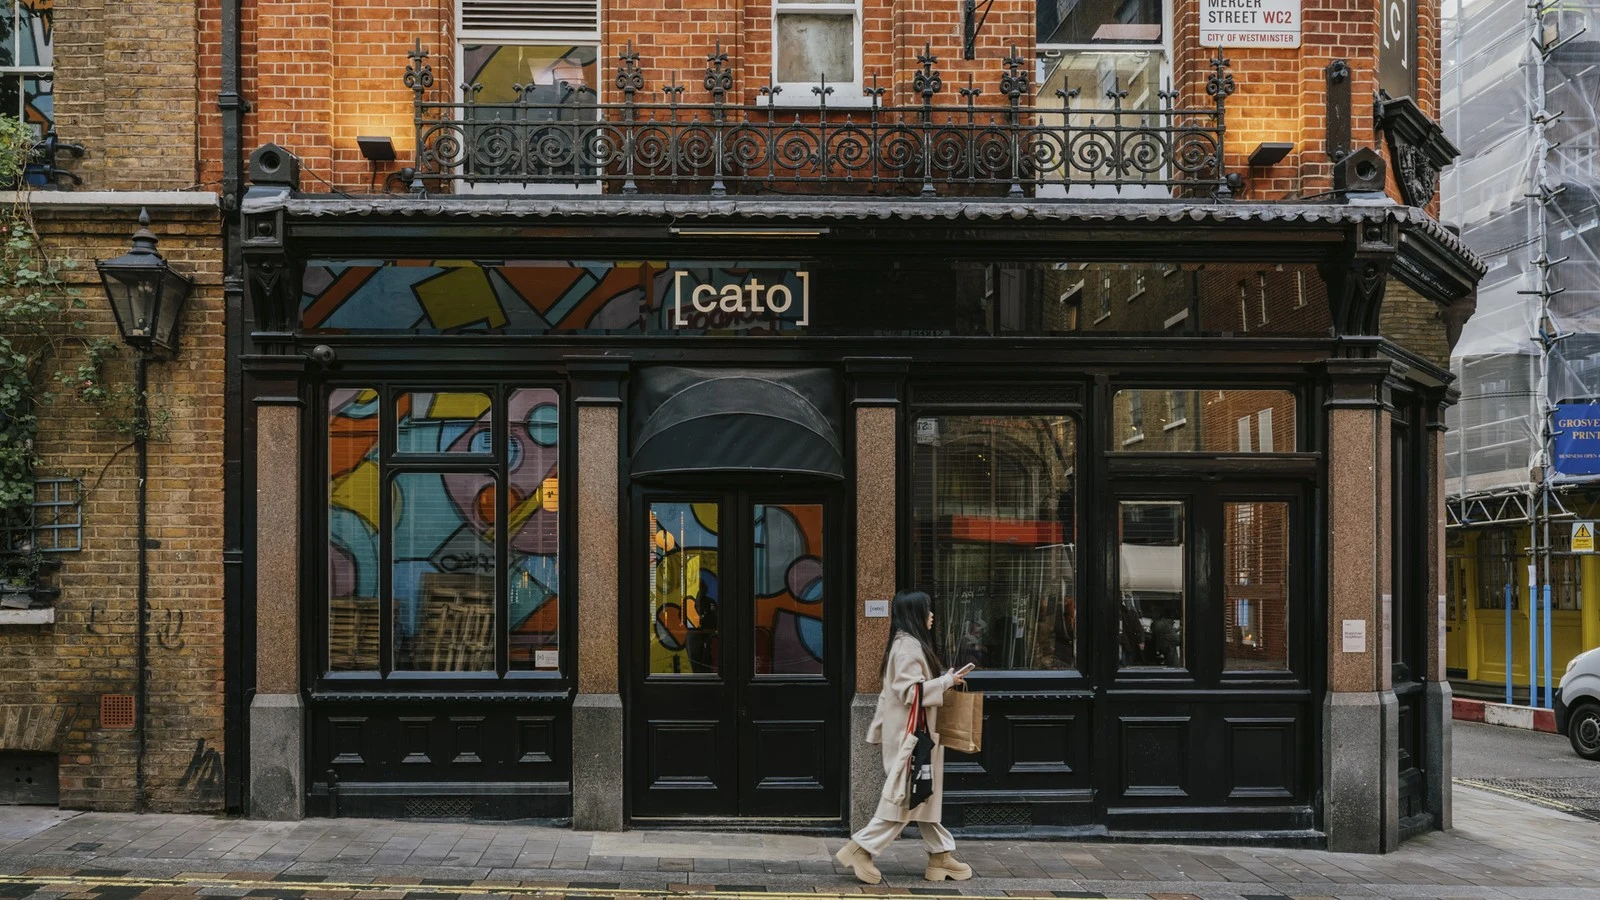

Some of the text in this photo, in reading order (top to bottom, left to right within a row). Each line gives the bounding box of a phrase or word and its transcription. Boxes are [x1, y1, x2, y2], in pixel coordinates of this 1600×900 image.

[1208, 10, 1292, 24] STREET WC2
[1207, 33, 1294, 43] CITY OF WESTMINSTER
[674, 270, 809, 326] [cato]
[1558, 419, 1600, 428] GROSVE
